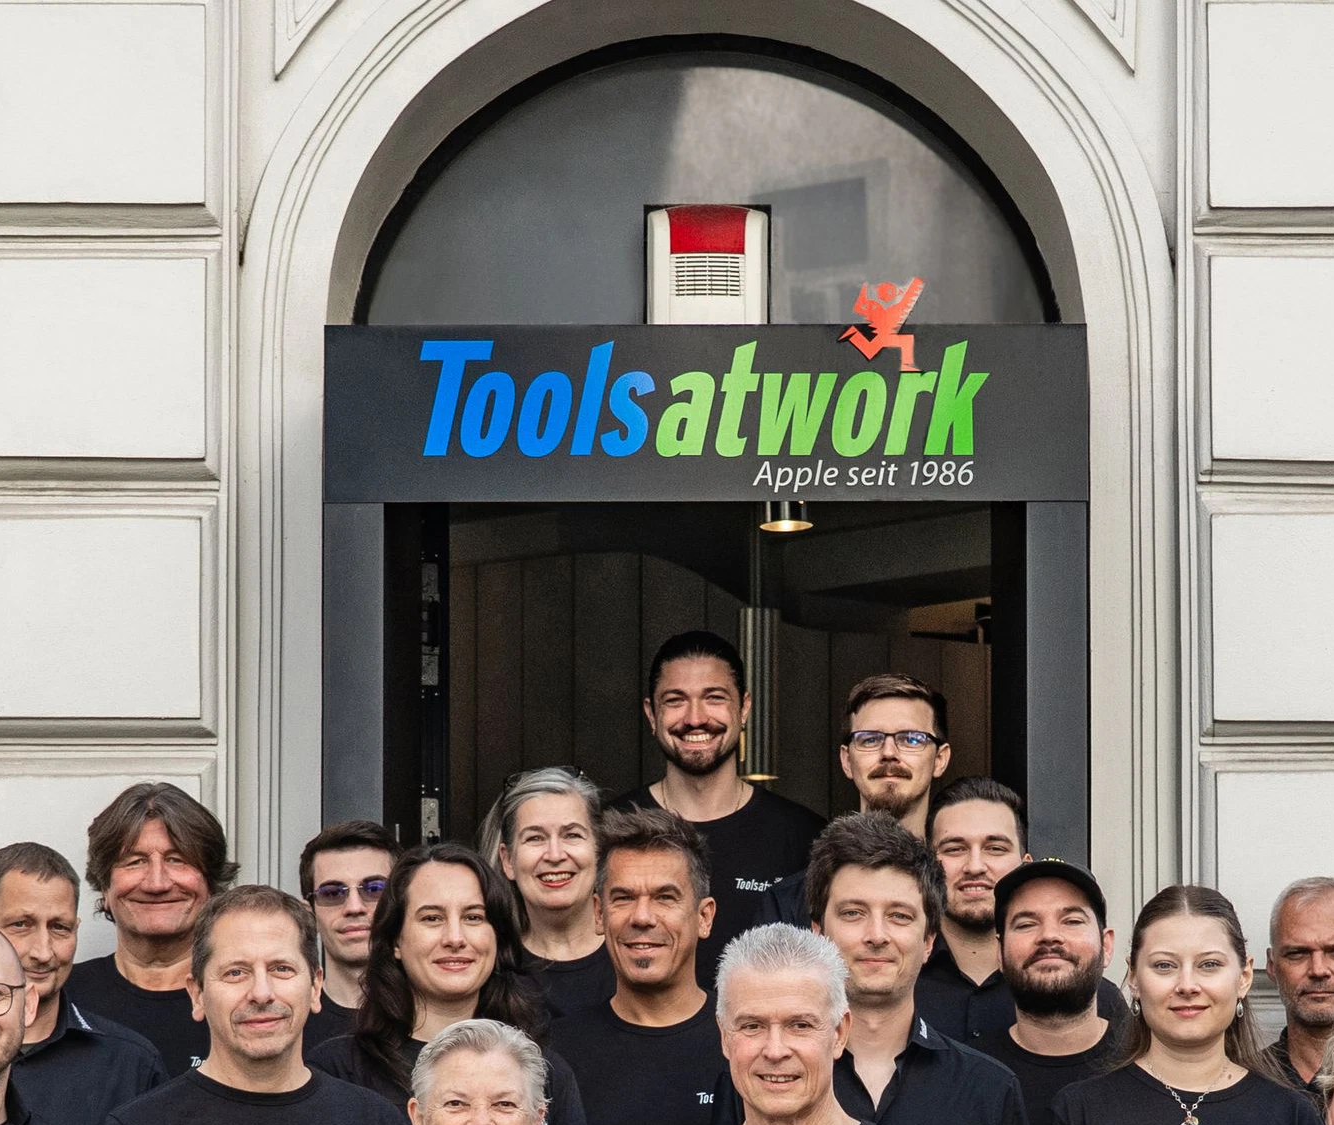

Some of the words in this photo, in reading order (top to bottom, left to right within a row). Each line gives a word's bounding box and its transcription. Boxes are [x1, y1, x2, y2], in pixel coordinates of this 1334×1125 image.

[419, 340, 990, 458] Toolsatwork
[752, 459, 839, 493] Apple
[846, 460, 899, 486] seit
[909, 460, 974, 486] 1986
